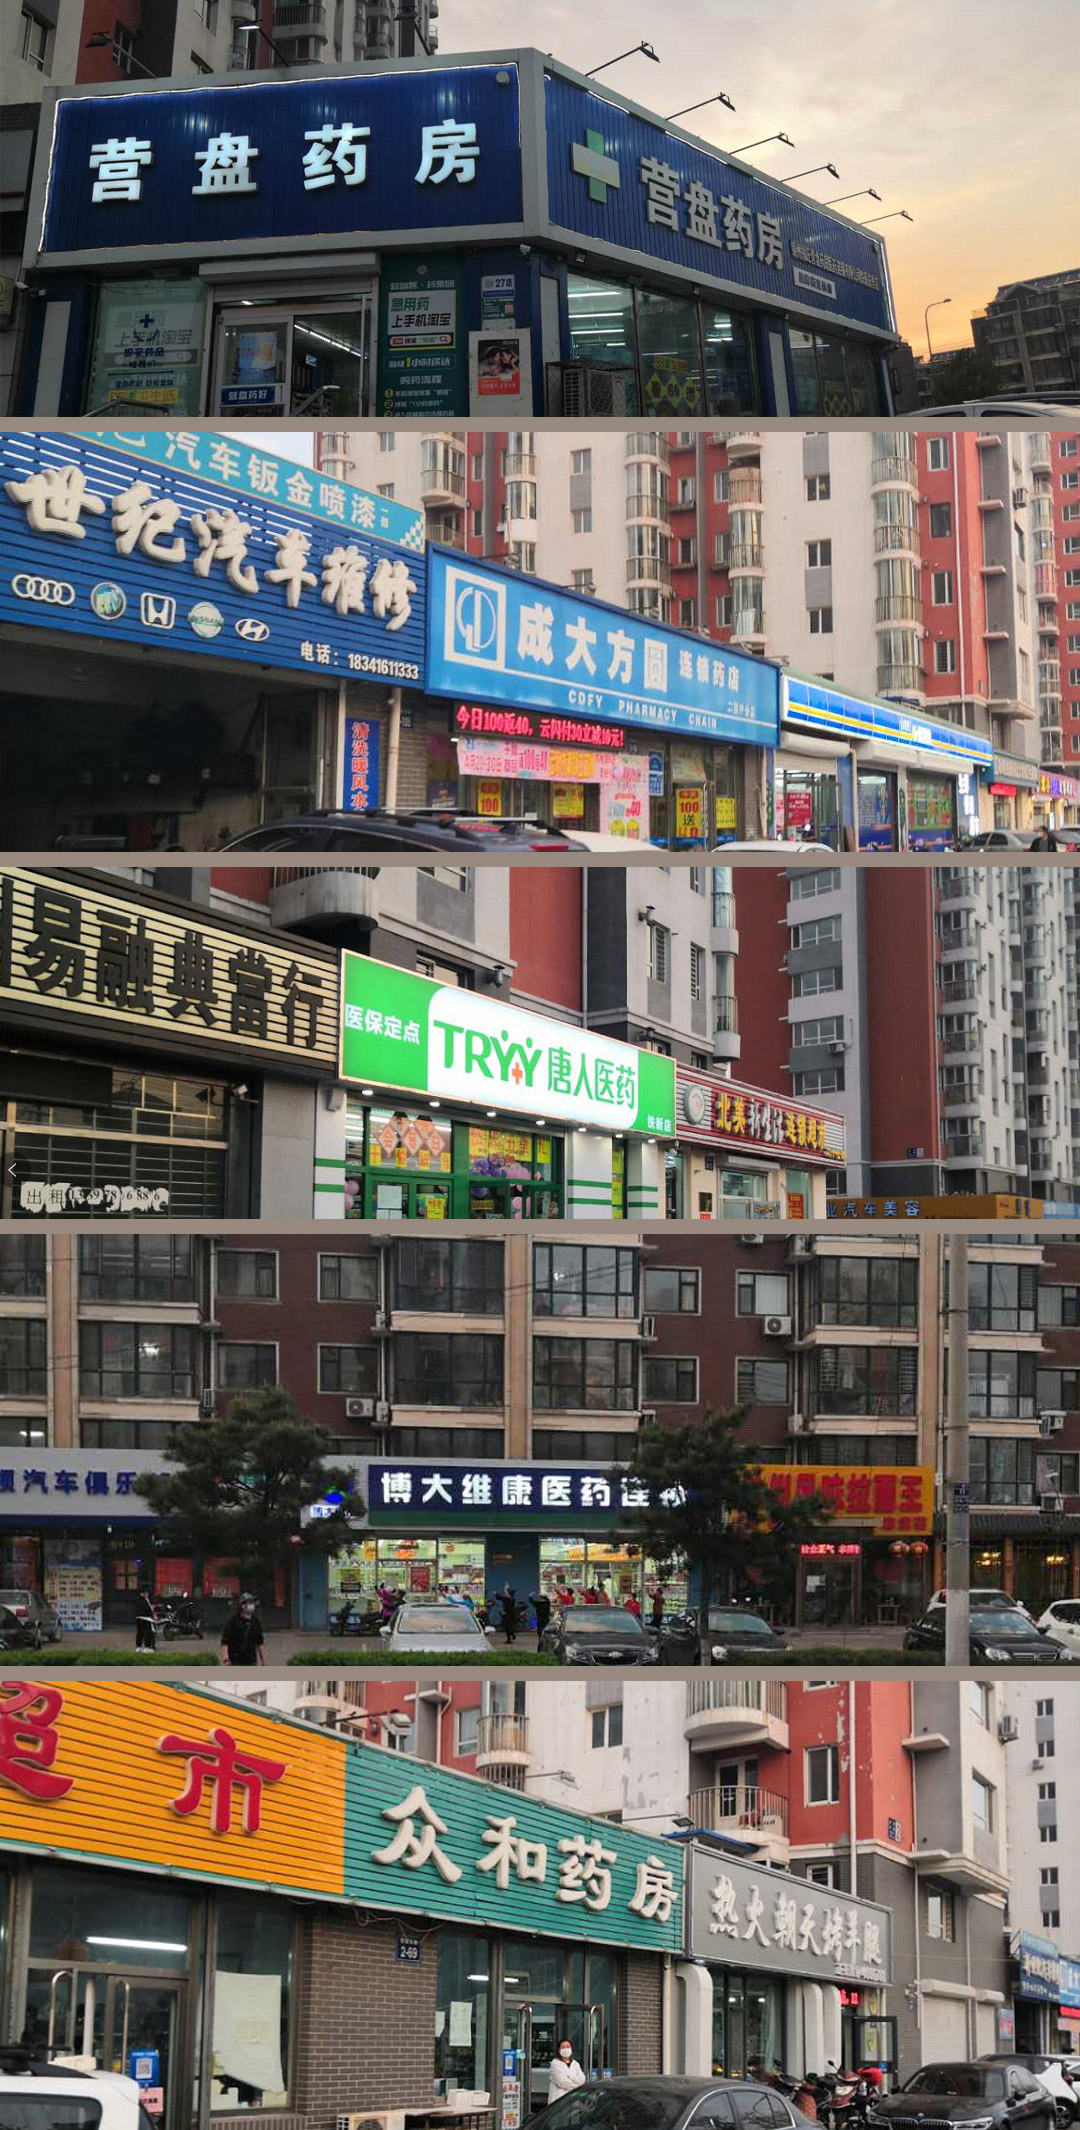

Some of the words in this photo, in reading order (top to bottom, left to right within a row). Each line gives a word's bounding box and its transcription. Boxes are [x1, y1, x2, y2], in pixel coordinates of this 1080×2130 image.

[89, 119, 480, 204] 营盘药房
[639, 156, 785, 271] 营盘药房
[391, 297, 430, 312] 急用药
[391, 313, 452, 328] 上手机淘宝
[4, 465, 418, 632] 世纪汽车维修
[347, 652, 419, 681] 18341611333
[679, 649, 740, 693] 连锁药店
[568, 689, 603, 709] CDFY
[618, 700, 678, 723] PHARMACY
[689, 712, 717, 730] CHAIN
[481, 798, 498, 812] 100
[679, 802, 699, 813] 100
[683, 815, 695, 826] 送
[344, 1002, 421, 1046] 医保定点
[547, 1046, 637, 1109] 唐人医药
[646, 1114, 672, 1133] 铁新店
[27, 1188, 63, 1206] 出租
[0, 1469, 170, 1496] 汽车俱乐
[371, 1786, 679, 1923] 众和药房
[709, 1873, 884, 1968] 热火朝天烤羊腿
[400, 1945, 418, 1959] 2-69
